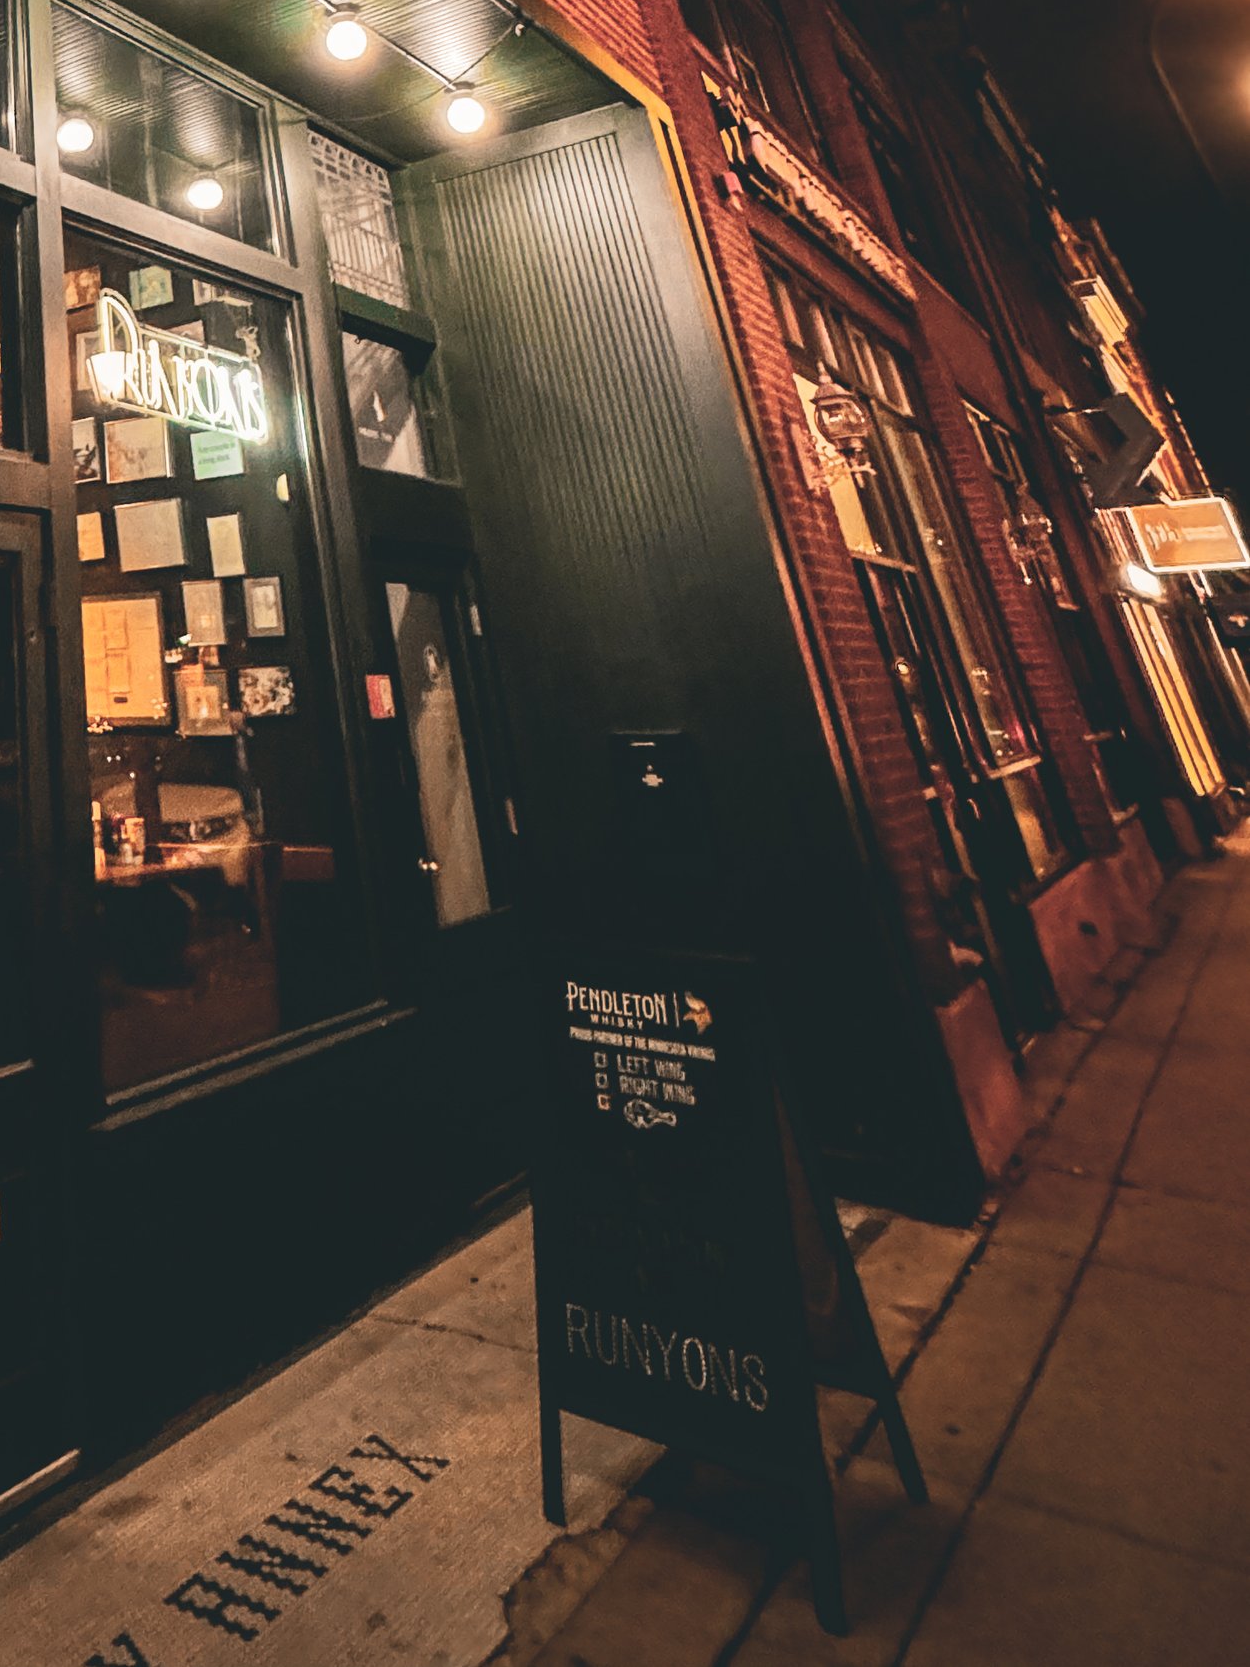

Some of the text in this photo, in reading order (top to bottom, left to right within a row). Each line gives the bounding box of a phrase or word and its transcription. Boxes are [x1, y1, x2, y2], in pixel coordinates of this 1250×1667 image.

[565, 981, 668, 1025] PENDLETON
[590, 1014, 643, 1030] WHISKY
[616, 1054, 649, 1075] LEFT
[566, 1303, 768, 1412] RUNYONS
